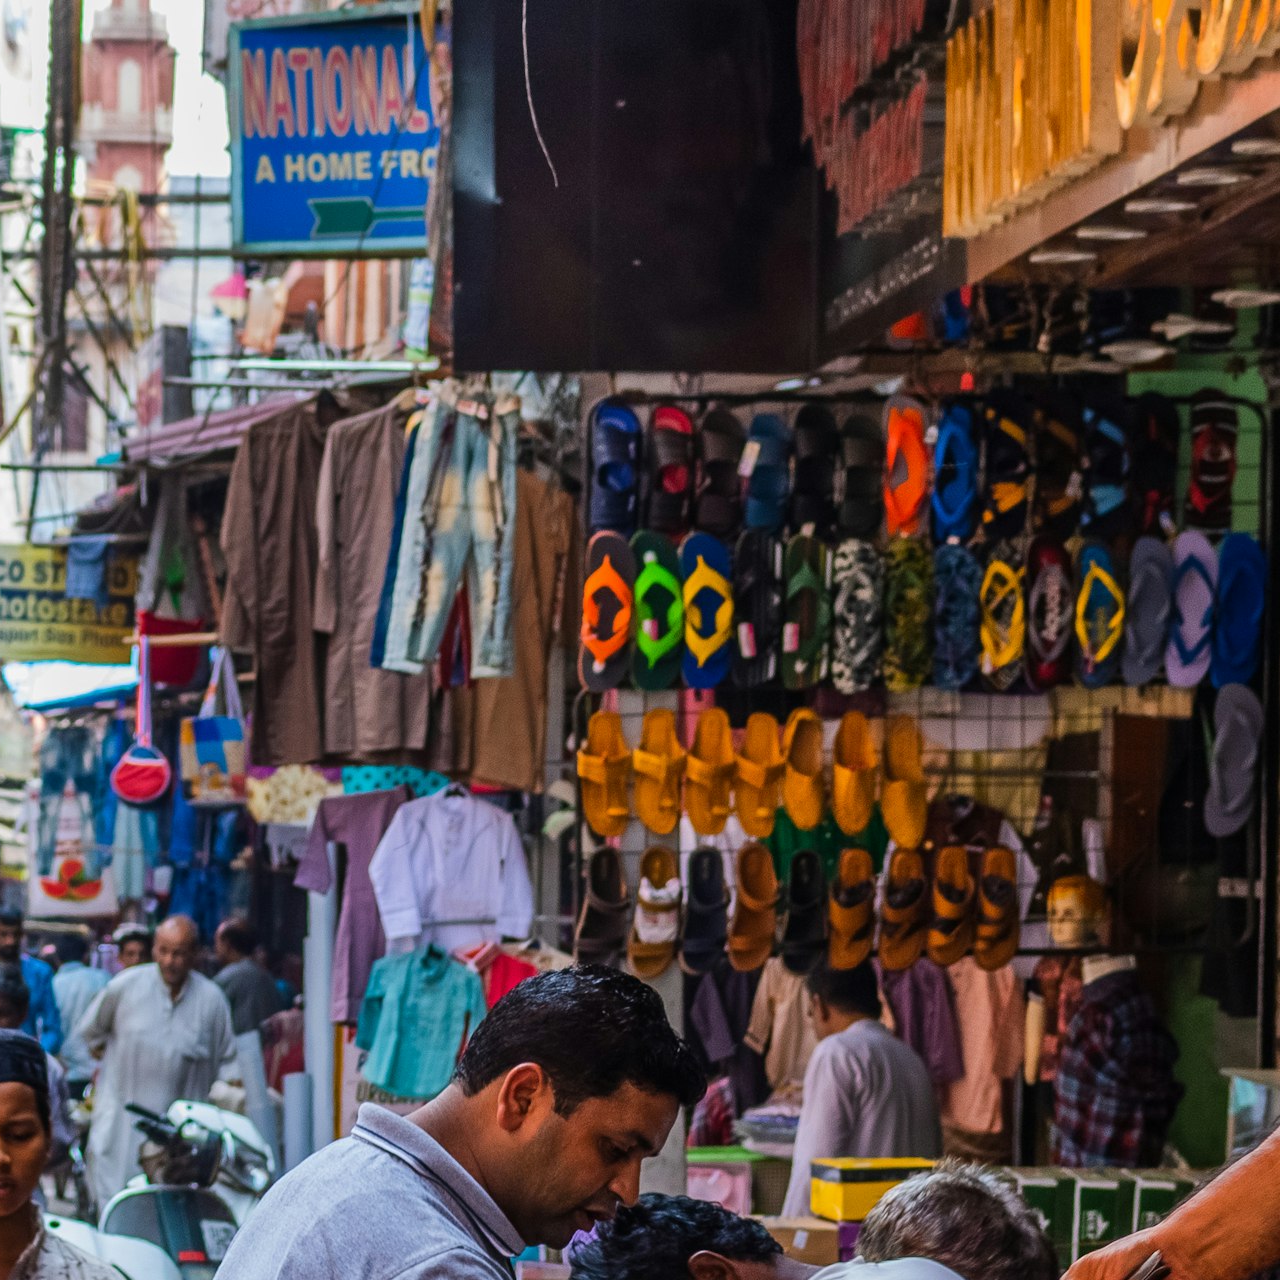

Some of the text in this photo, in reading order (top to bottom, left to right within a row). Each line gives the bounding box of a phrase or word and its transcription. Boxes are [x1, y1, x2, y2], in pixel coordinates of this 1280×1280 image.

[241, 45, 428, 139] NATIONAL
[255, 154, 276, 184] A
[284, 151, 374, 183] HOME
